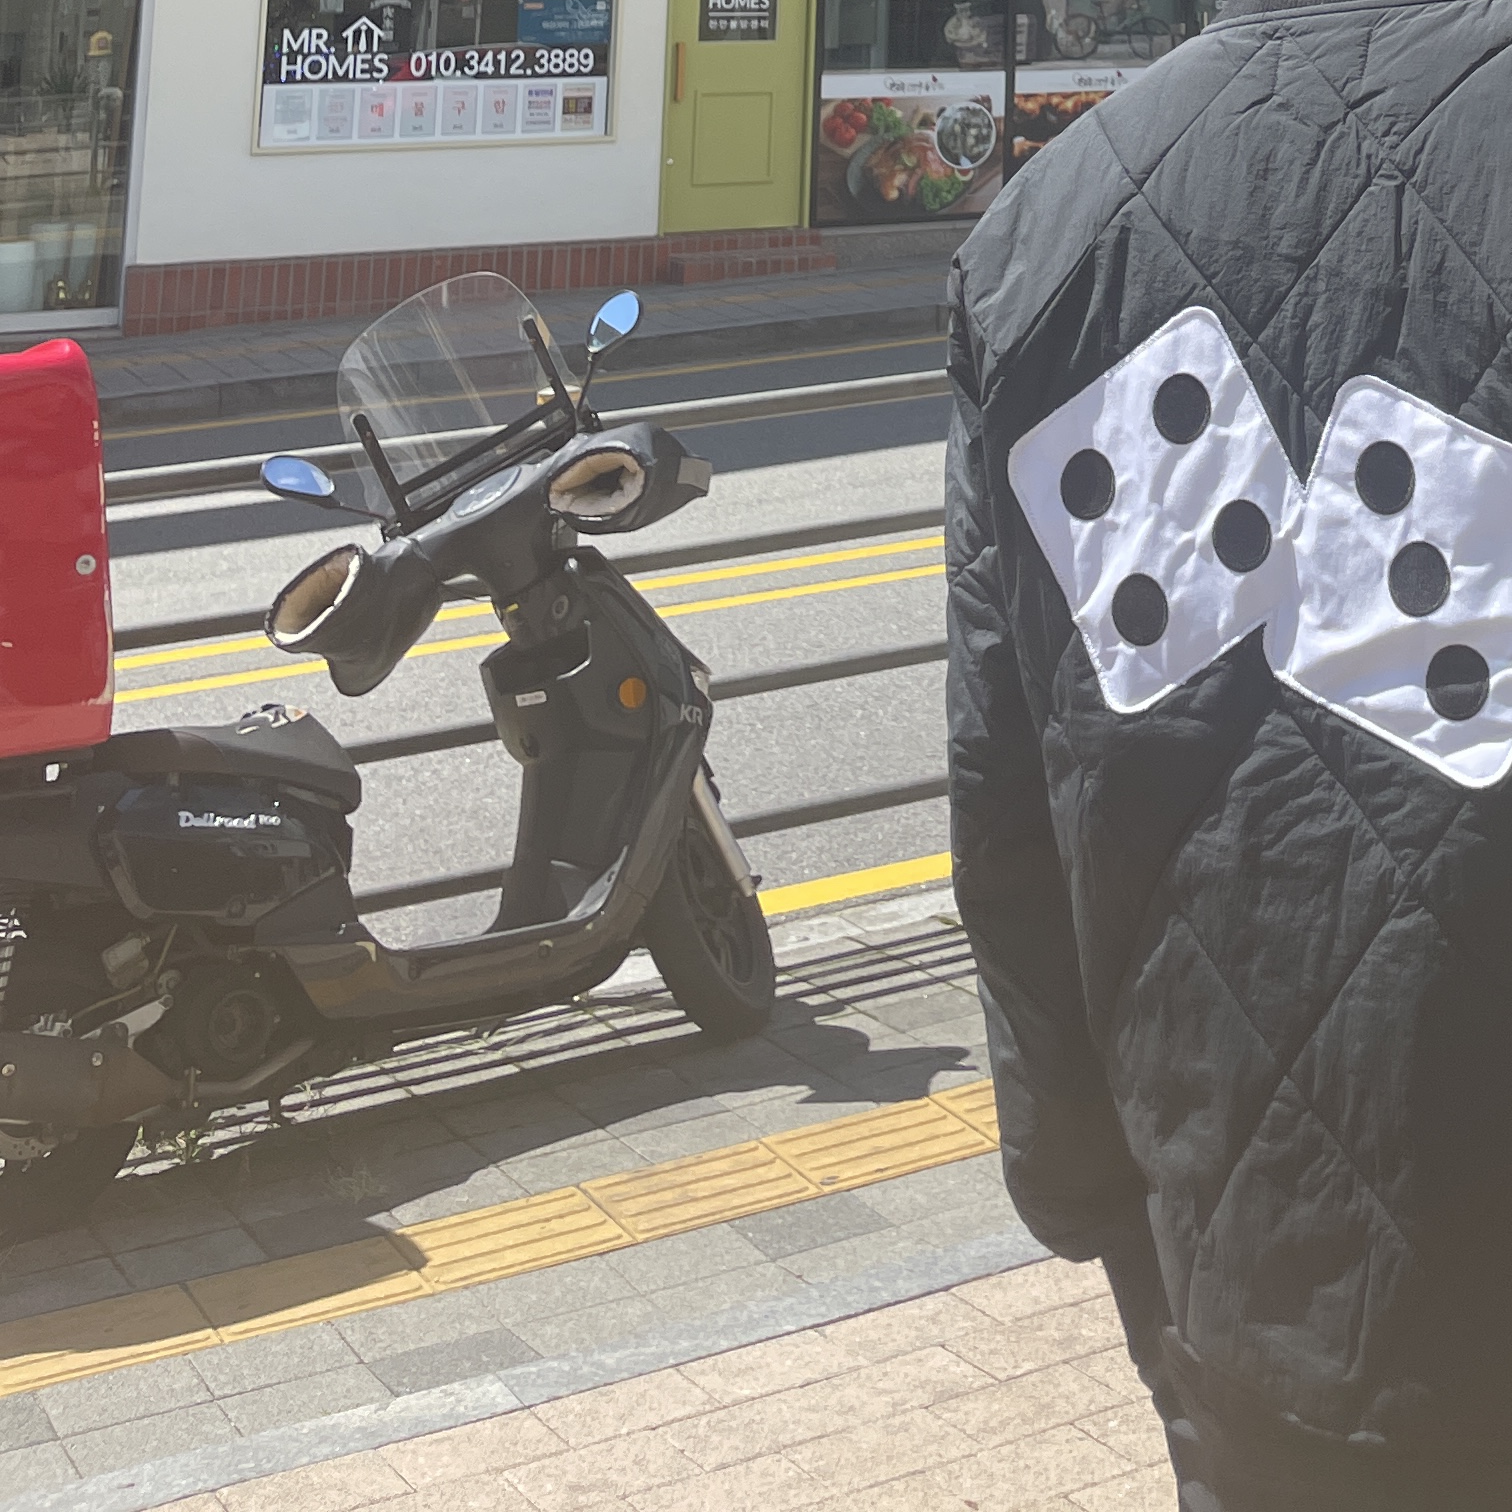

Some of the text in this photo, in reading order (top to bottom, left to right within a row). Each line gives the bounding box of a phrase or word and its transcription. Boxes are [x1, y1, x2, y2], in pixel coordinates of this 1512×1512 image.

[282, 28, 335, 54] MR.
[281, 48, 595, 81] HOMES 010.3412.3889
[680, 704, 703, 726] KR
